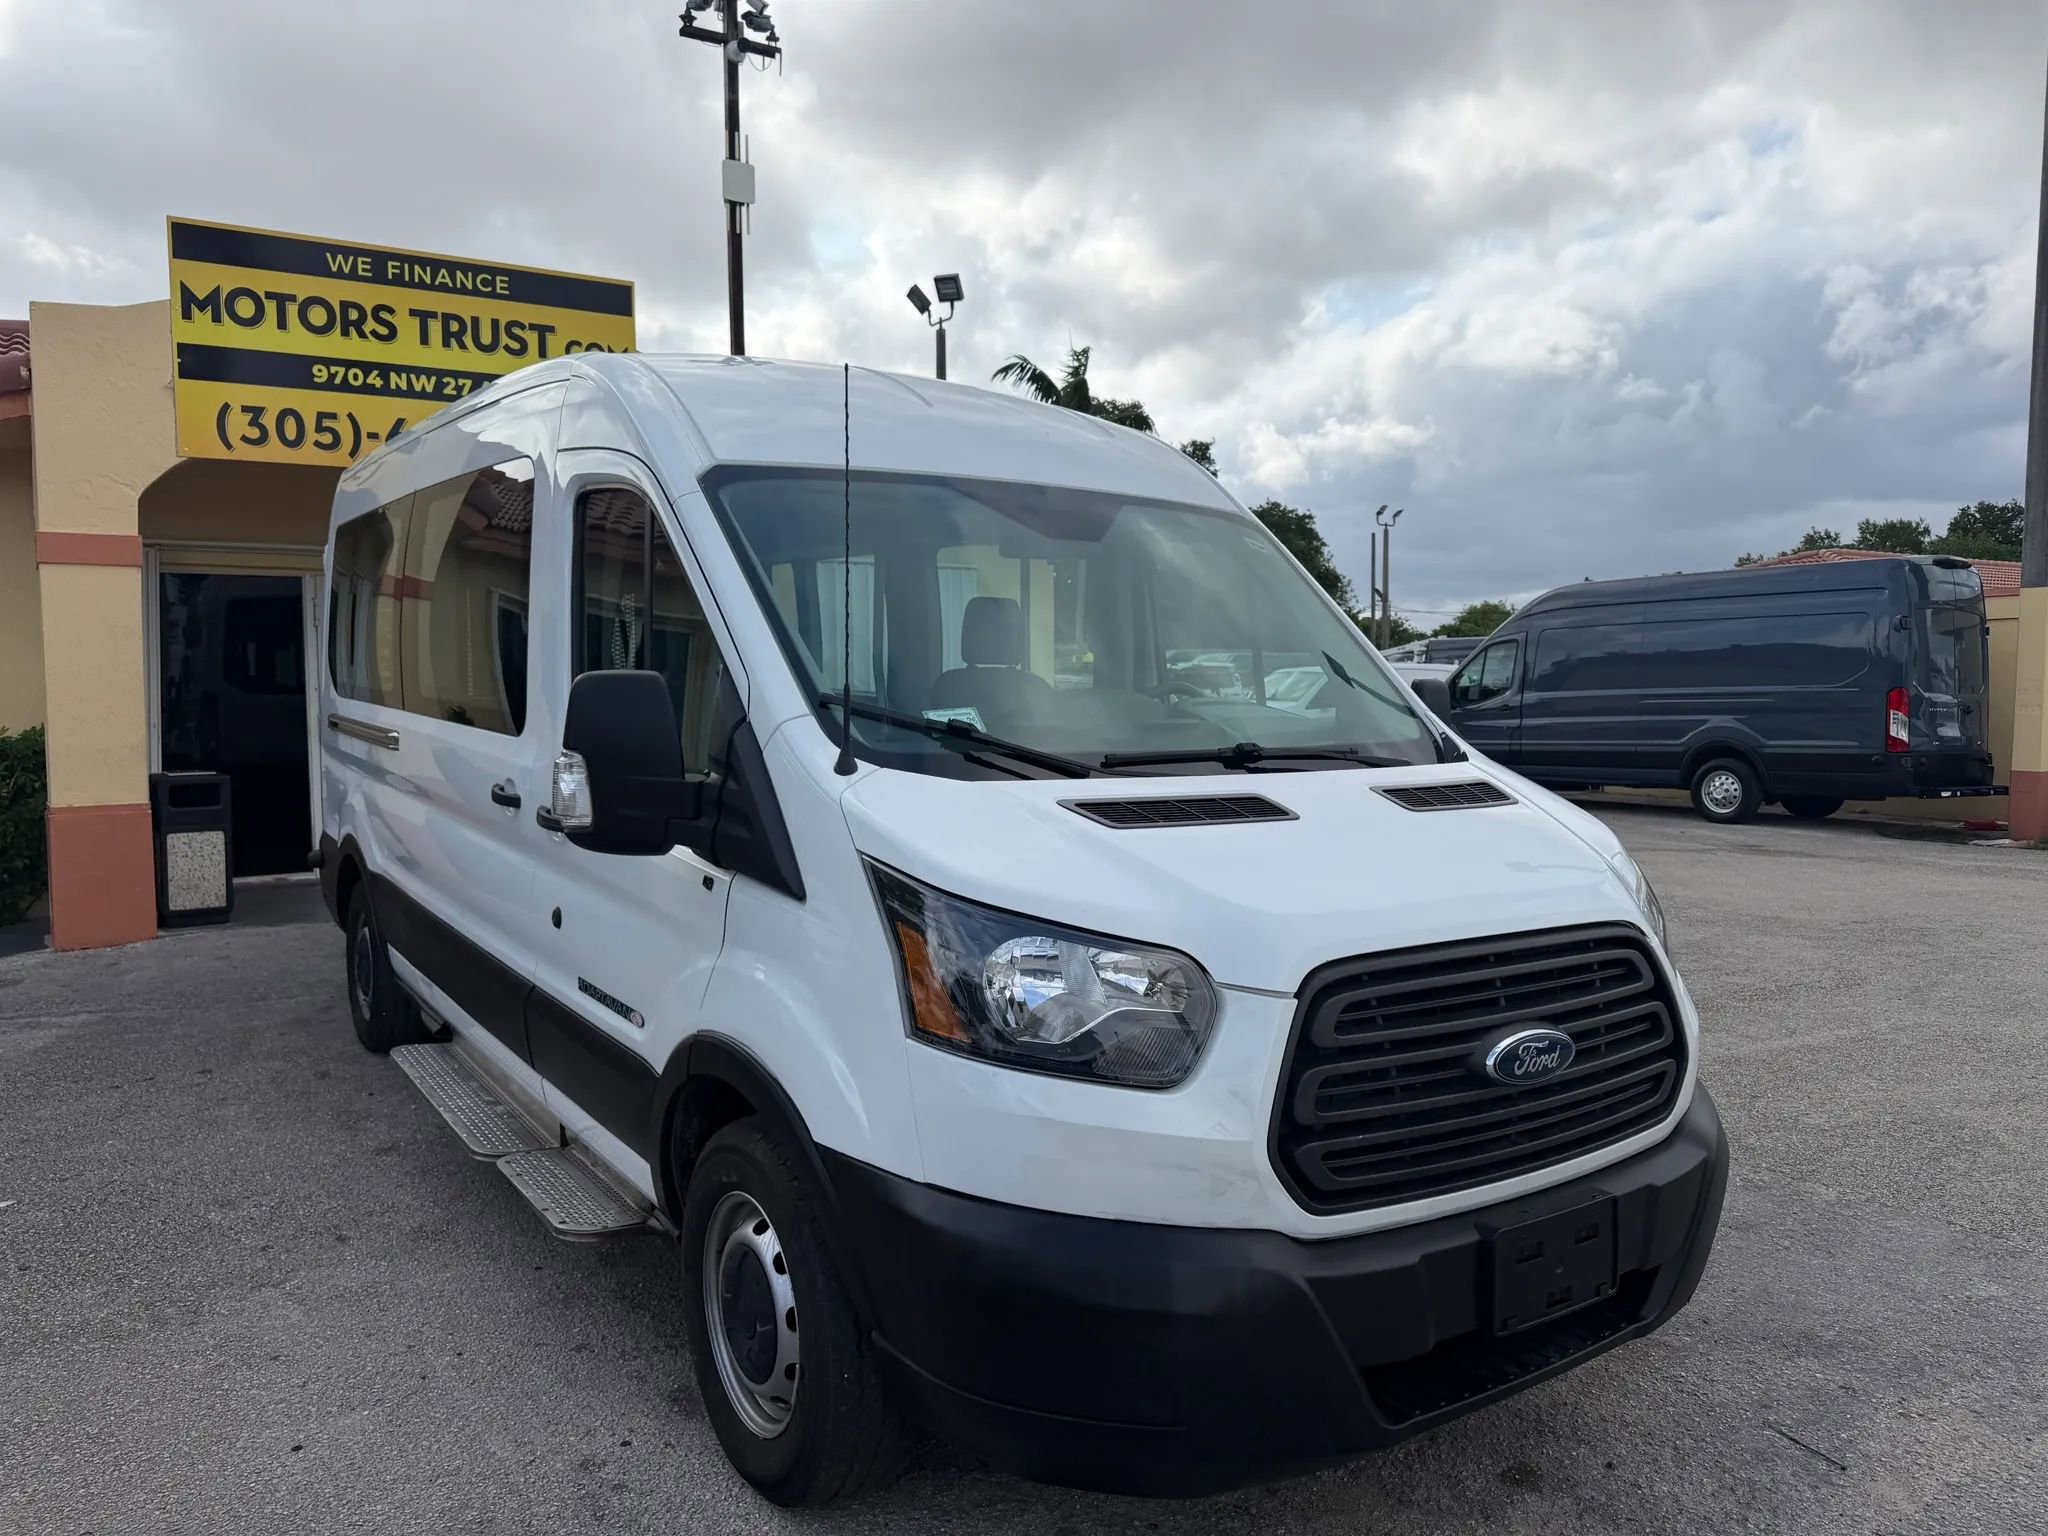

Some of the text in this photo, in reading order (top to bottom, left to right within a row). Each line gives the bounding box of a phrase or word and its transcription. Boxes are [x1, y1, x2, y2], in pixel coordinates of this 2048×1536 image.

[326, 252, 510, 294] WE FINANCE
[180, 279, 398, 343] MOTORS
[408, 308, 555, 360] TRUST
[312, 364, 384, 388] 9704
[390, 371, 436, 393] NW
[442, 376, 473, 396] 27
[1514, 1040, 1561, 1075] Ford
